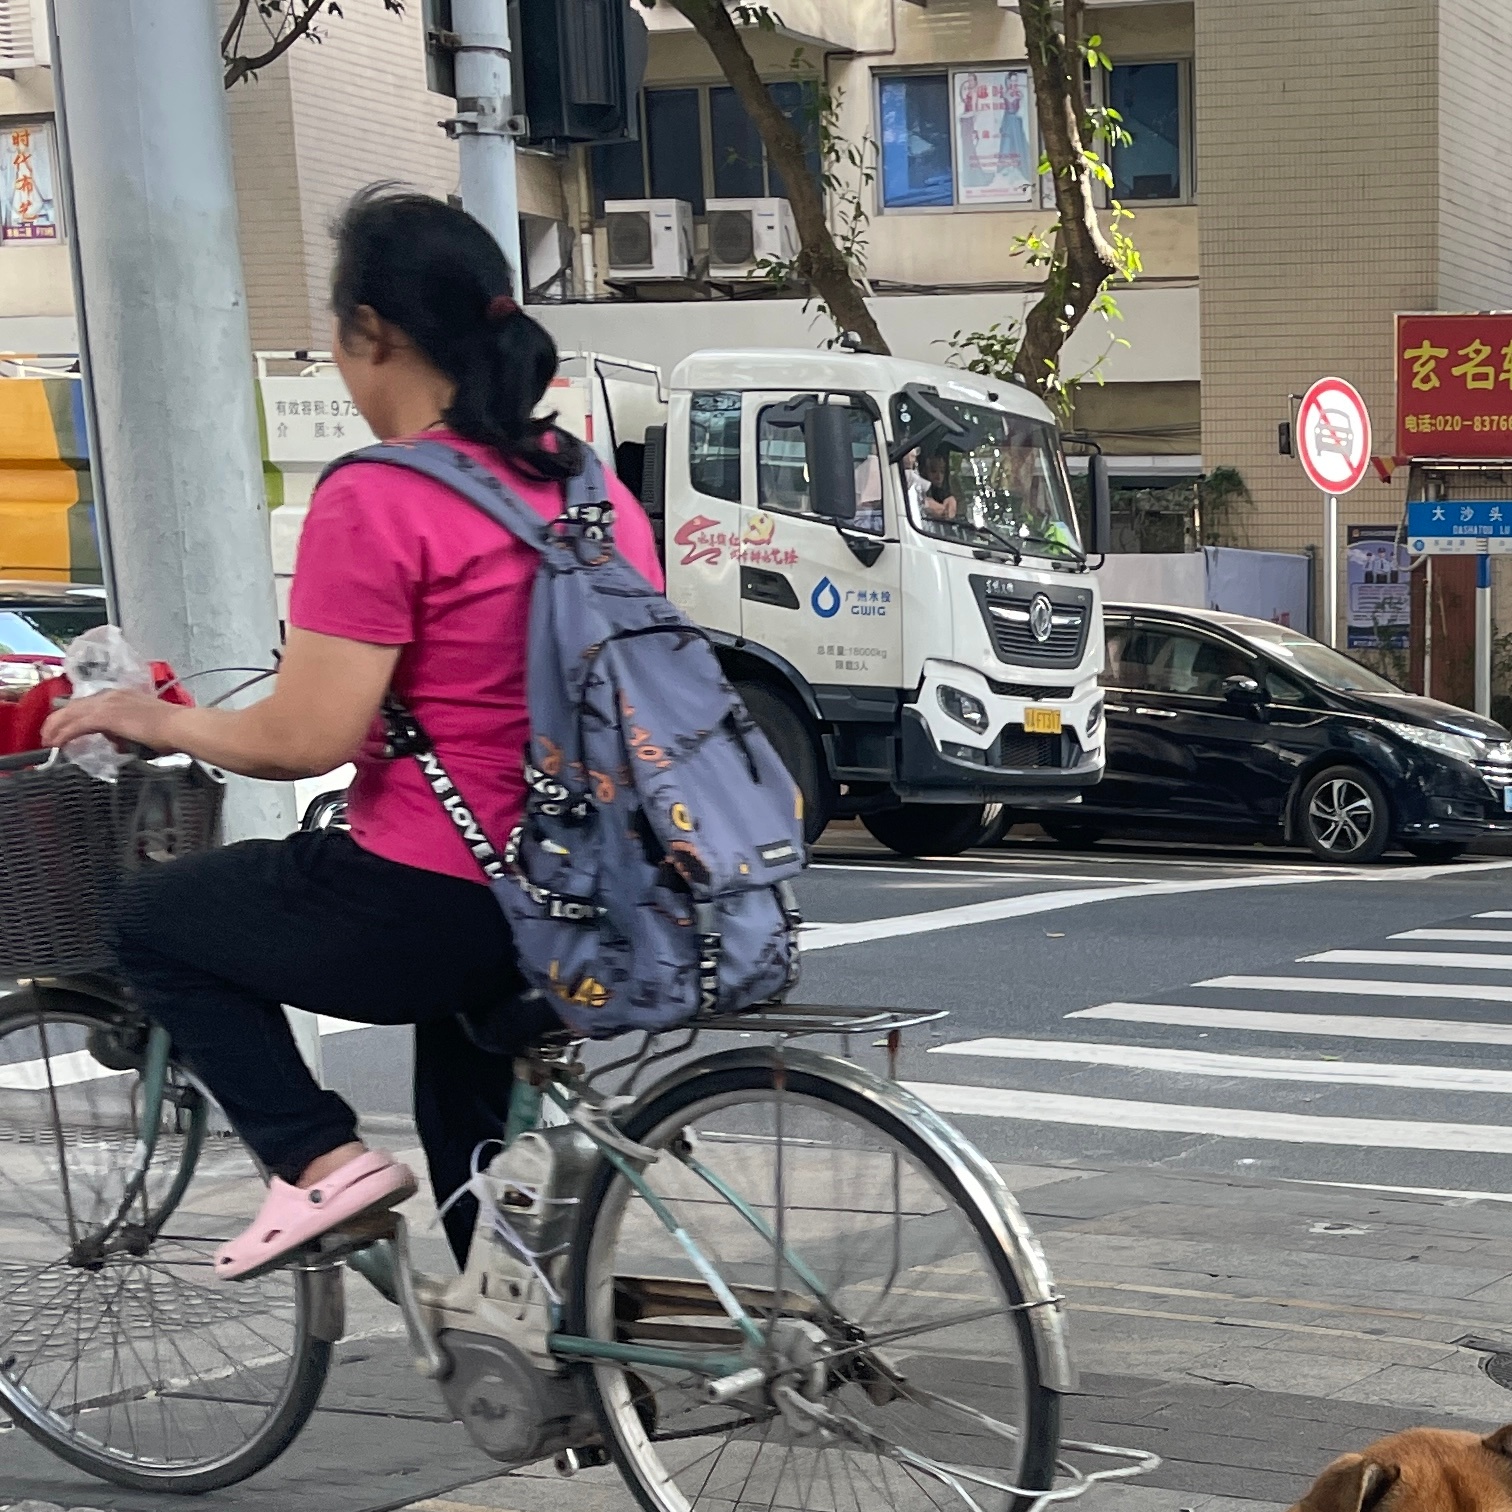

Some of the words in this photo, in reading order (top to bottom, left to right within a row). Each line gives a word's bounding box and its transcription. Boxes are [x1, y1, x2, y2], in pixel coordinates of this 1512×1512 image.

[11, 127, 33, 222] 时代布艺
[845, 590, 891, 603] 广州水投
[851, 605, 886, 616] GWIG
